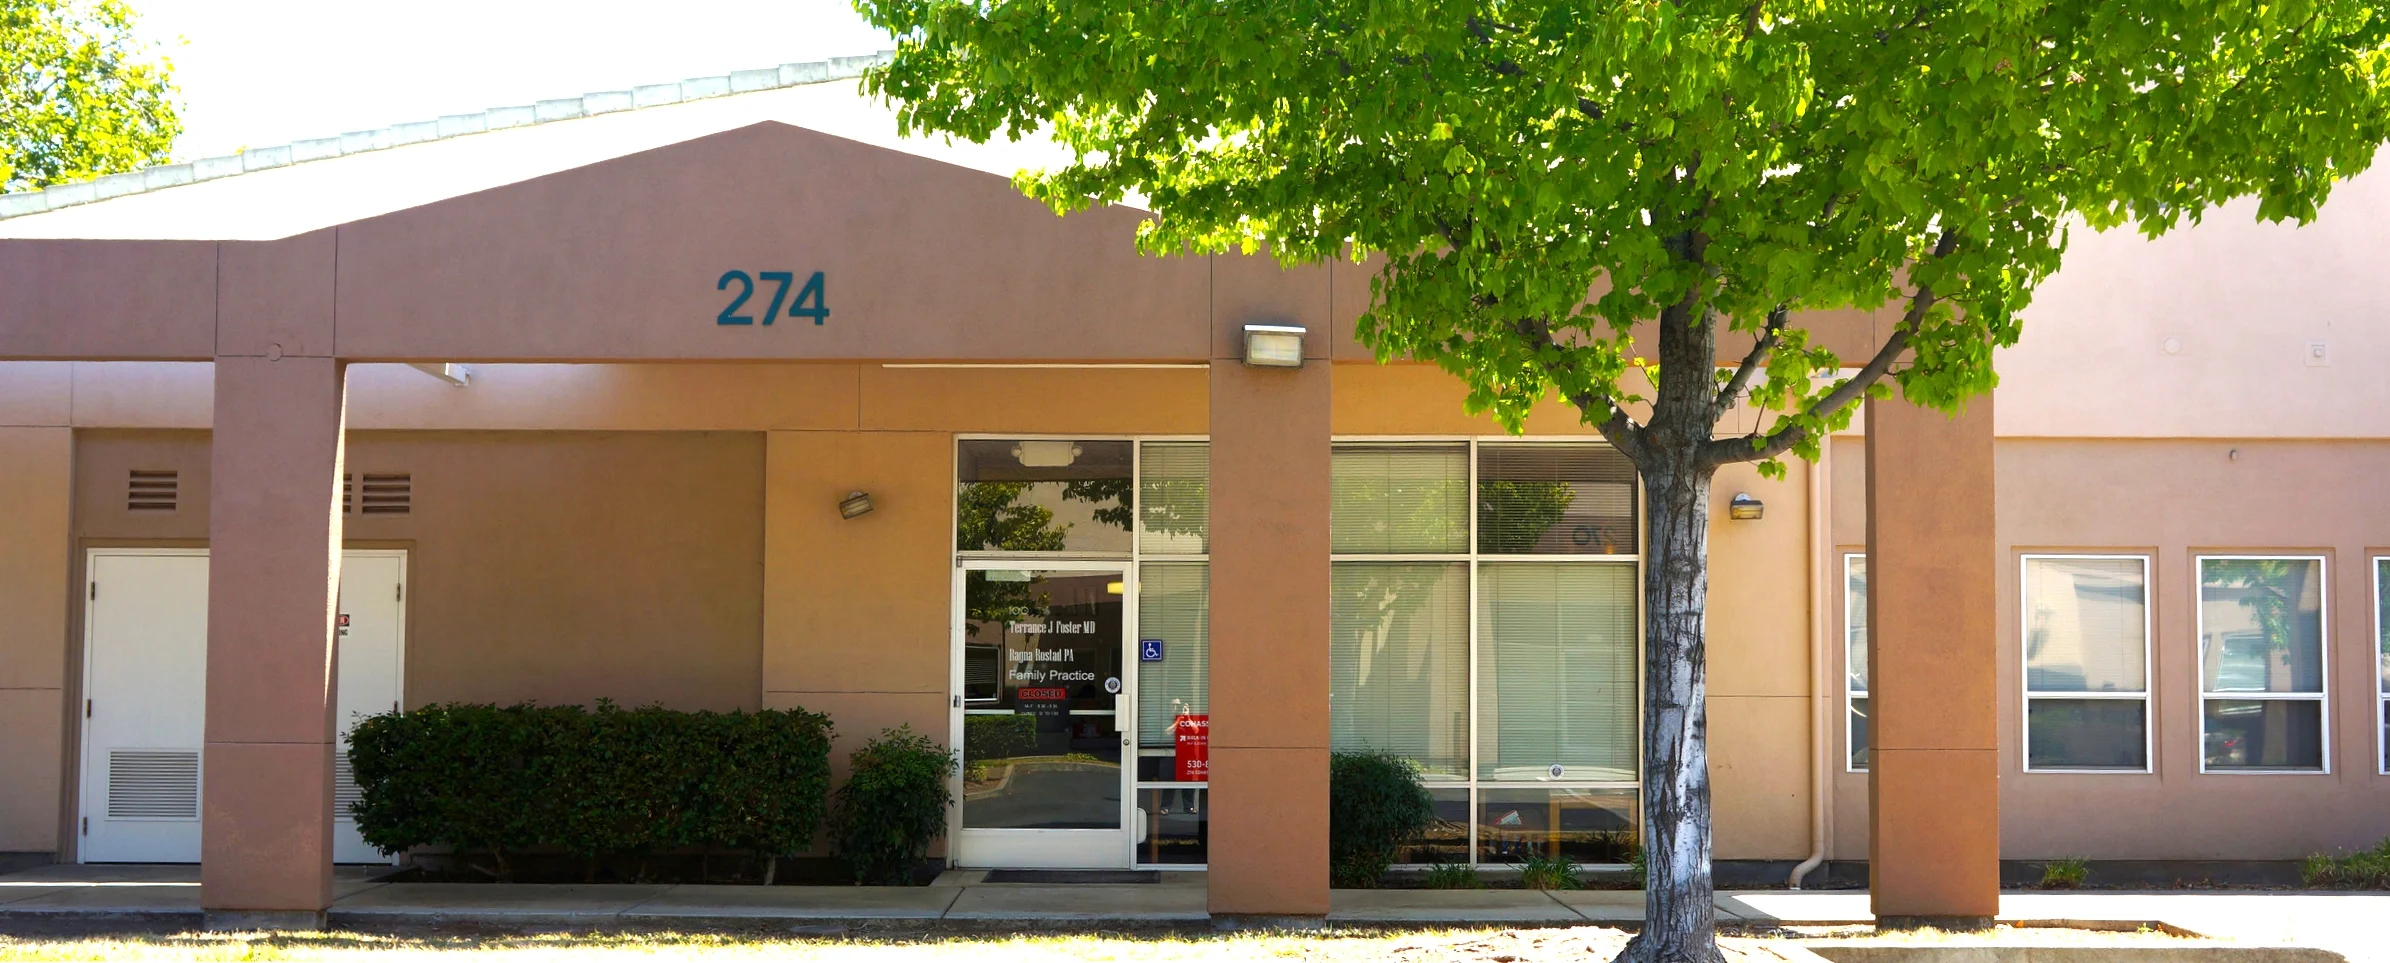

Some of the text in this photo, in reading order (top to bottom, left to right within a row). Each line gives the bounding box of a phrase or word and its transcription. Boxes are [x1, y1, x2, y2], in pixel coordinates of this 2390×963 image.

[716, 269, 830, 326] 274
[1009, 620, 1096, 634] Terrance J Foster MD
[1009, 648, 1074, 664] Ragna Rostad PA
[1009, 669, 1095, 683] Family Practice
[1021, 690, 1062, 698] CLOSED
